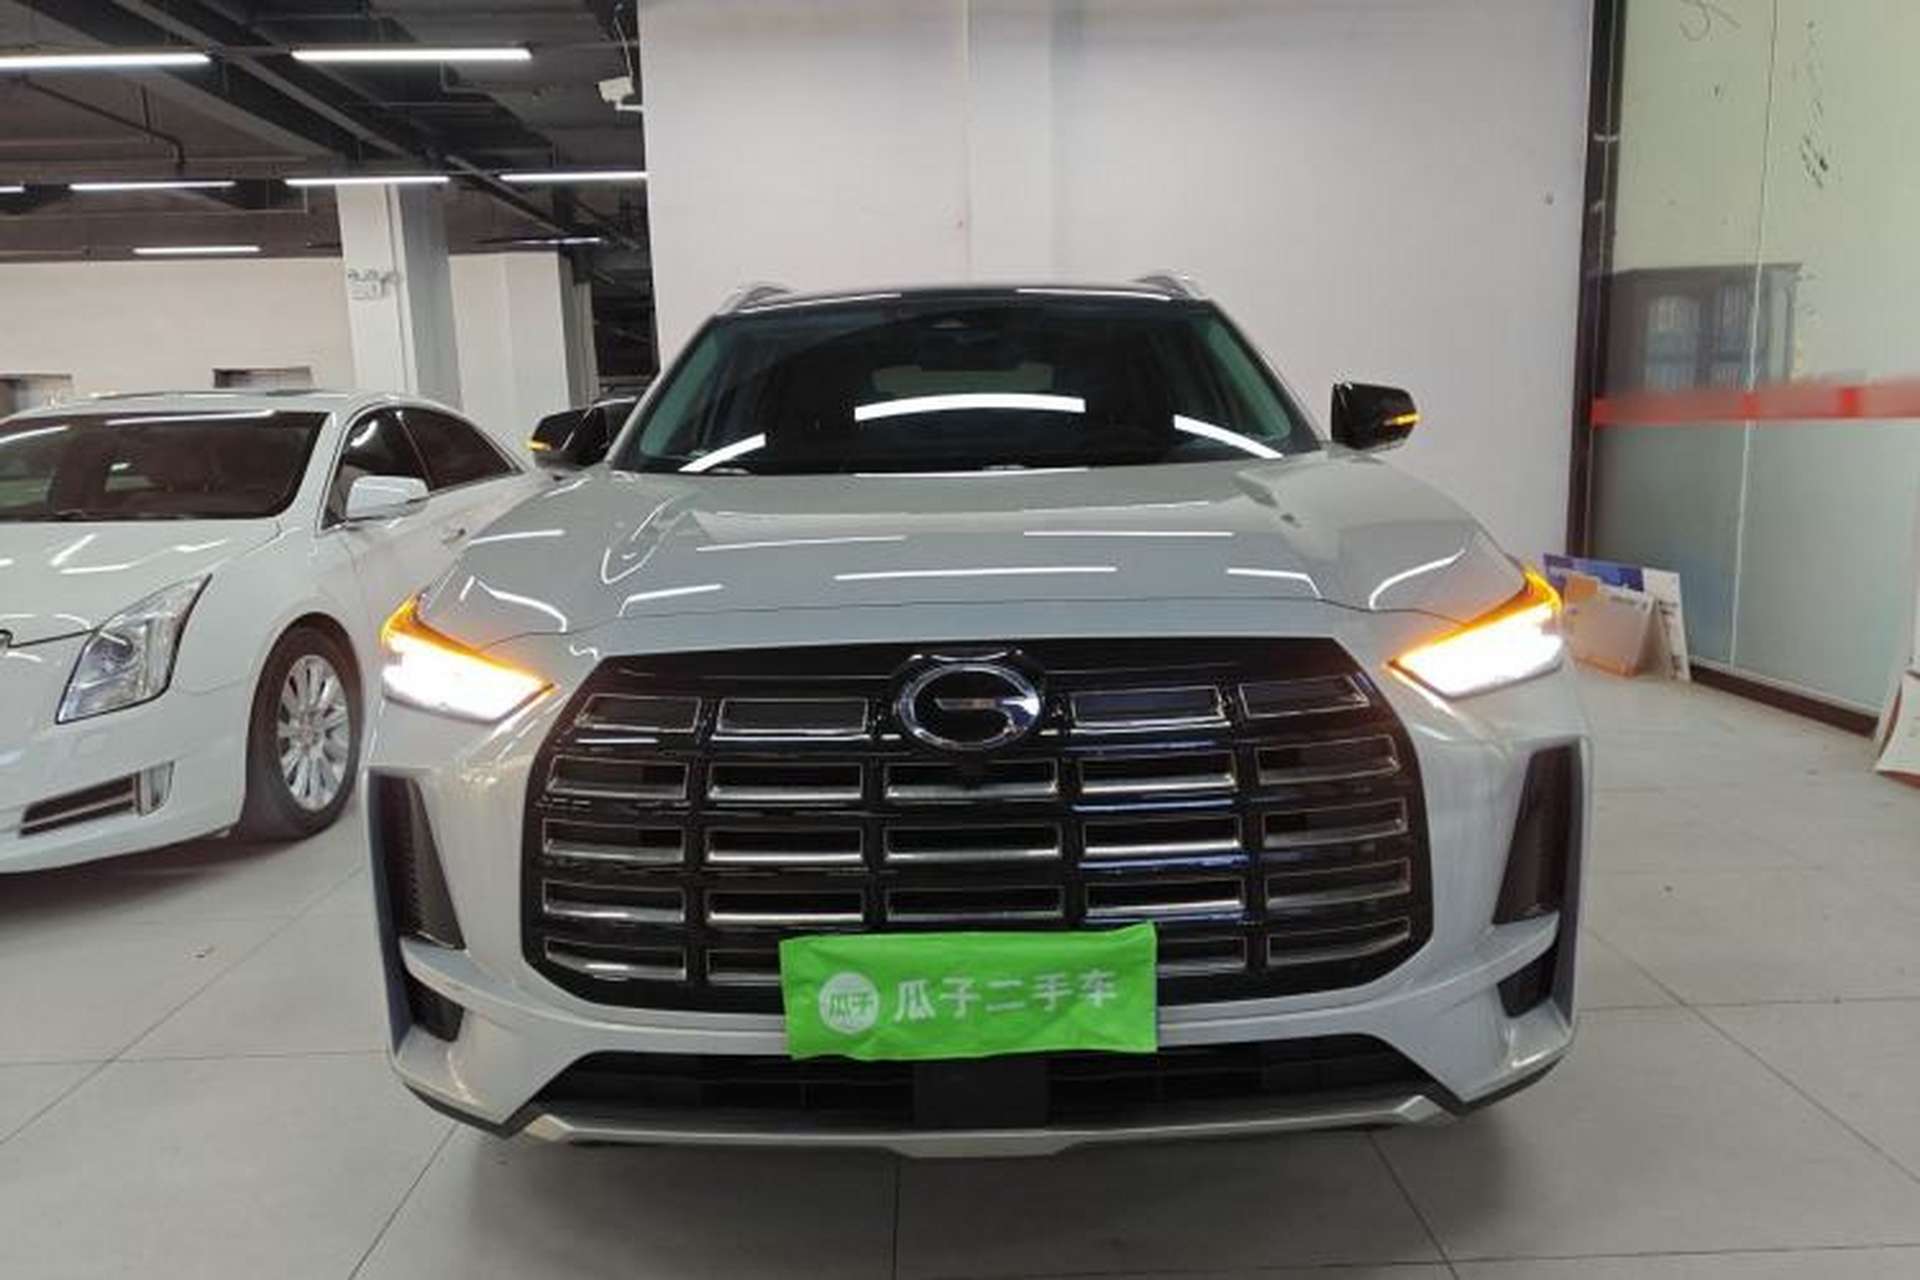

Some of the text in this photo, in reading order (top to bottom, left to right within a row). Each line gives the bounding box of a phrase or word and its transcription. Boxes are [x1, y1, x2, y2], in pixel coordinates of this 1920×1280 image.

[895, 968, 1117, 1022] 瓜子二手车
